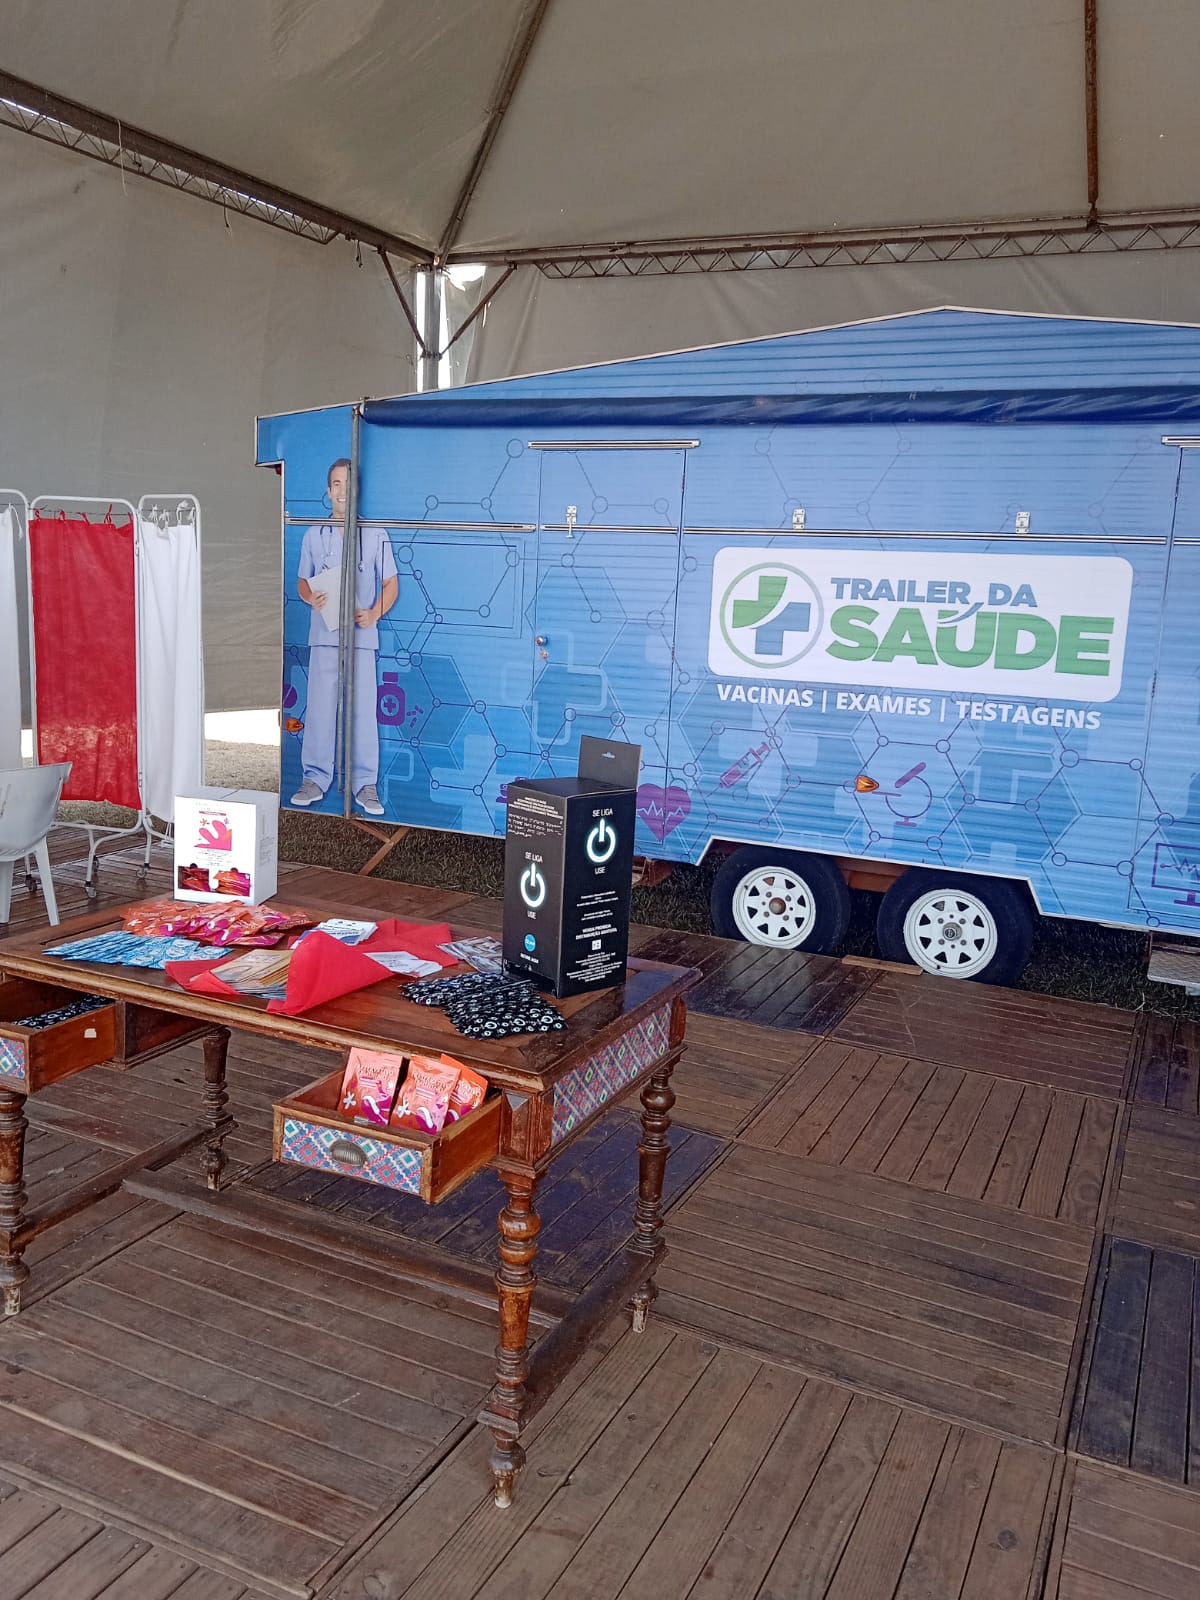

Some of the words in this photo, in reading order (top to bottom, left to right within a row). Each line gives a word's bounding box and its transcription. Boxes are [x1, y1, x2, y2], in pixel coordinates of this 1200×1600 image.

[831, 577, 971, 605] TRAILER
[988, 583, 1038, 608] DA
[825, 602, 1115, 677] SAÚDE
[717, 683, 814, 708] VACINAS
[836, 692, 931, 717] EXAMES
[956, 700, 1102, 730] TESTAGENS
[592, 809, 600, 817] SE
[601, 808, 613, 816] LIGA
[525, 851, 532, 860] SE
[532, 853, 543, 863] LIGA
[594, 867, 605, 875] USE
